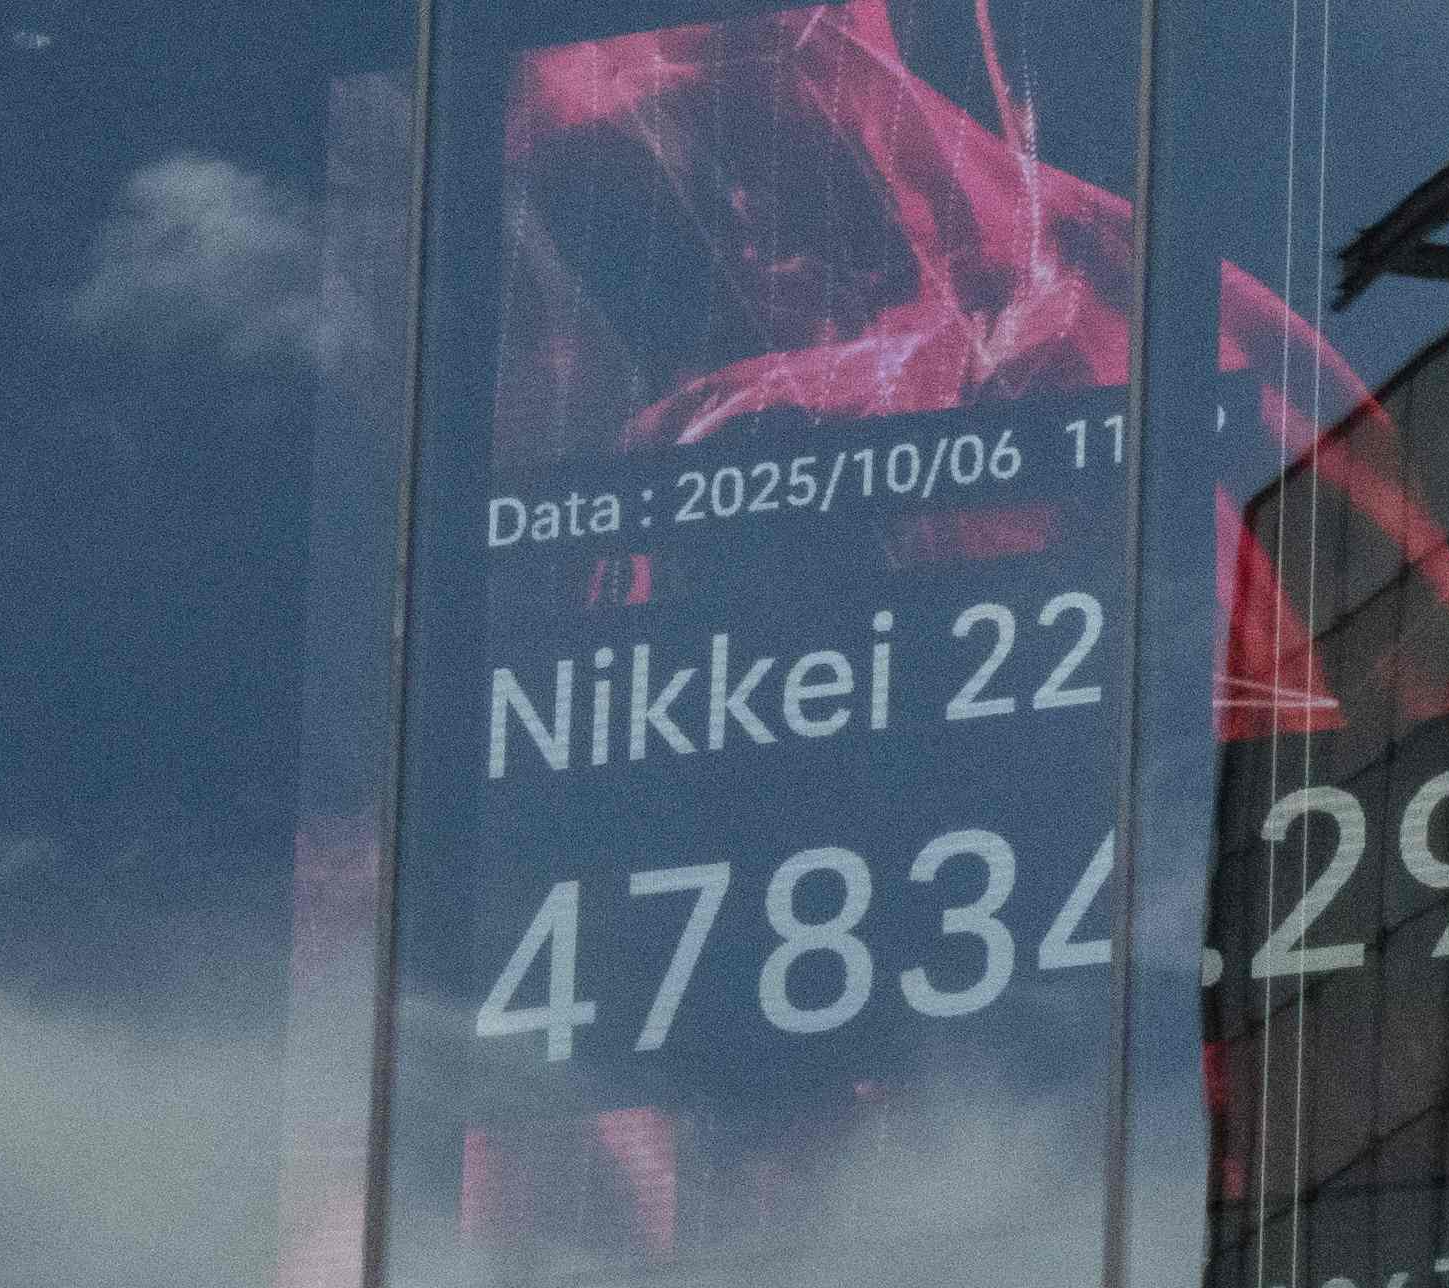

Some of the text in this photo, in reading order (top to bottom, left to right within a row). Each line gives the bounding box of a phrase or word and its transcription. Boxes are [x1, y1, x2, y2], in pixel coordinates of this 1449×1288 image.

[488, 491, 621, 547] Data
[673, 425, 1024, 524] 2025/10/06
[487, 608, 894, 780] Nikkei
